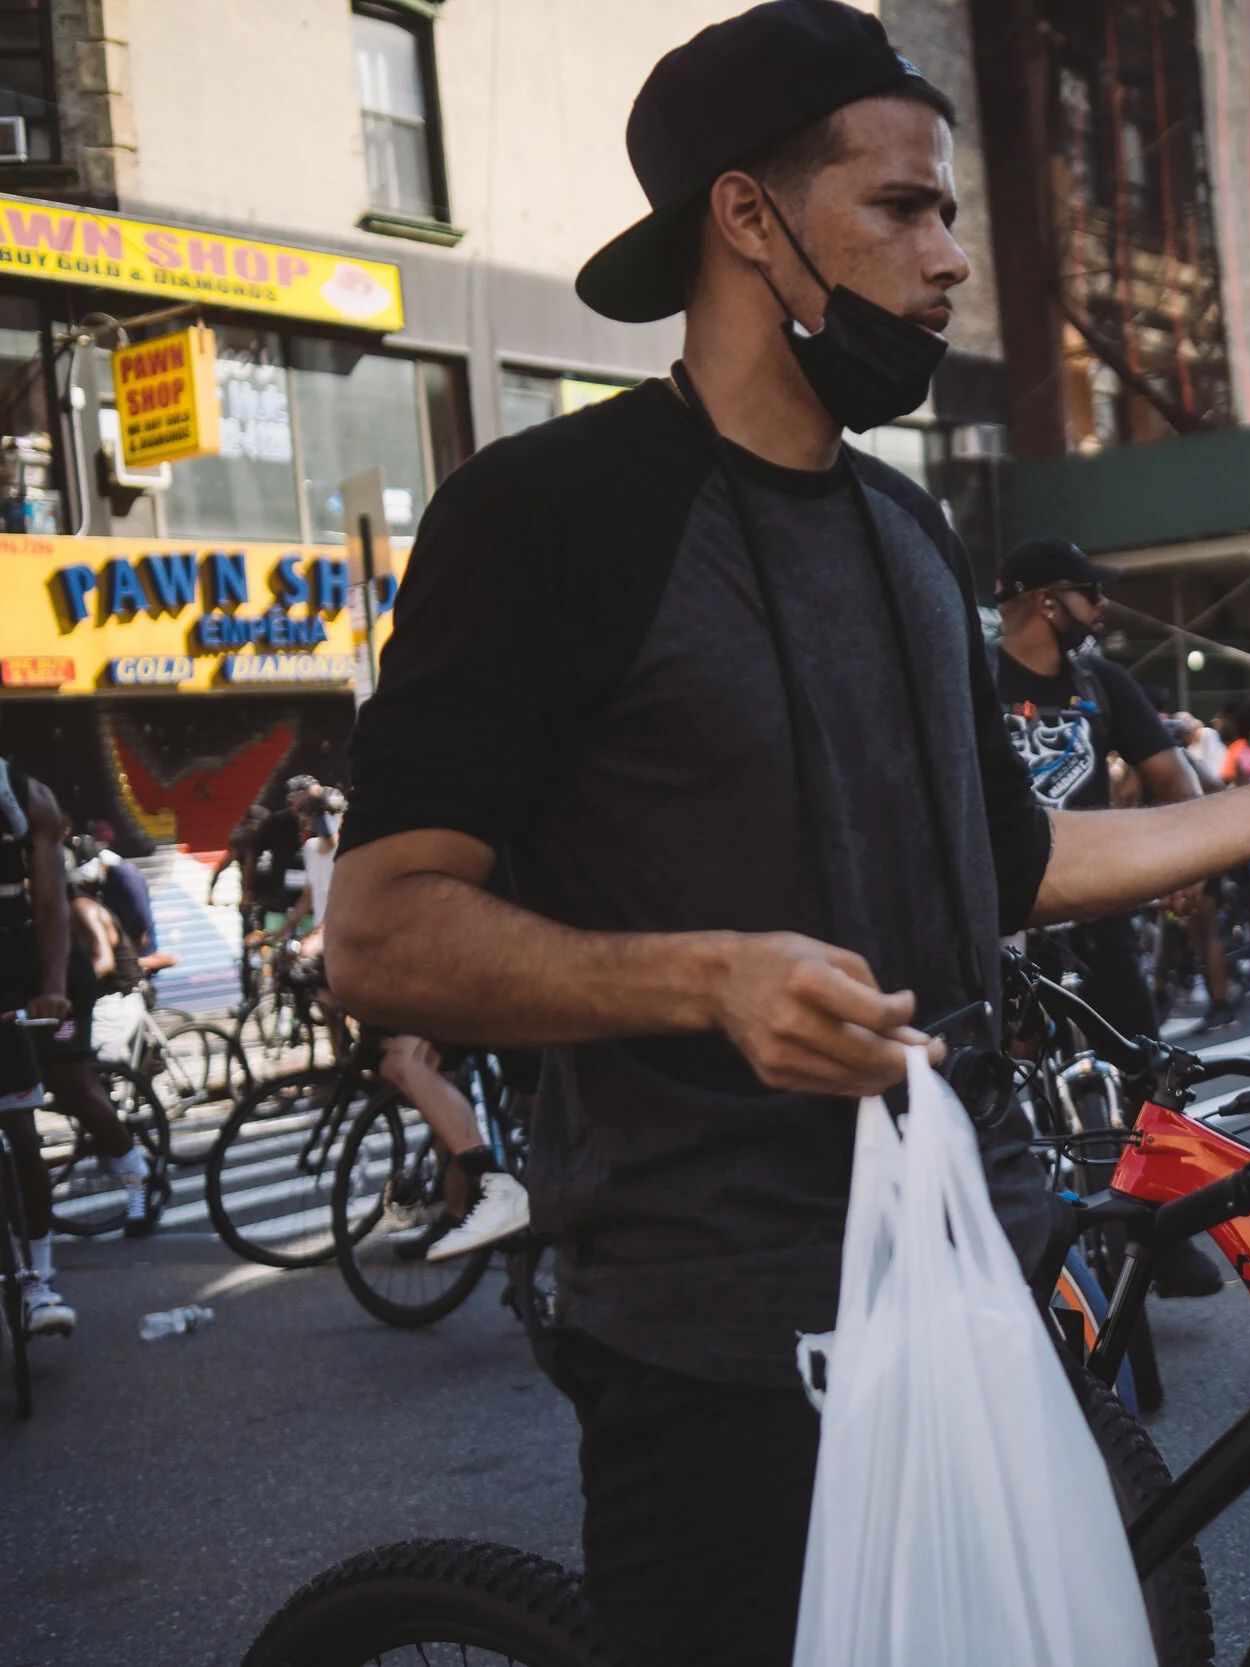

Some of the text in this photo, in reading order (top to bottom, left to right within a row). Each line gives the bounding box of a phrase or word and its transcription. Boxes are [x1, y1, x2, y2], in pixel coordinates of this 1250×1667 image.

[57, 254, 121, 278] GOLD
[142, 228, 311, 288] SHOP
[120, 341, 185, 384] PAWN
[126, 377, 185, 417] SHOP
[54, 551, 250, 629] PAWN
[115, 656, 191, 680] GOLD
